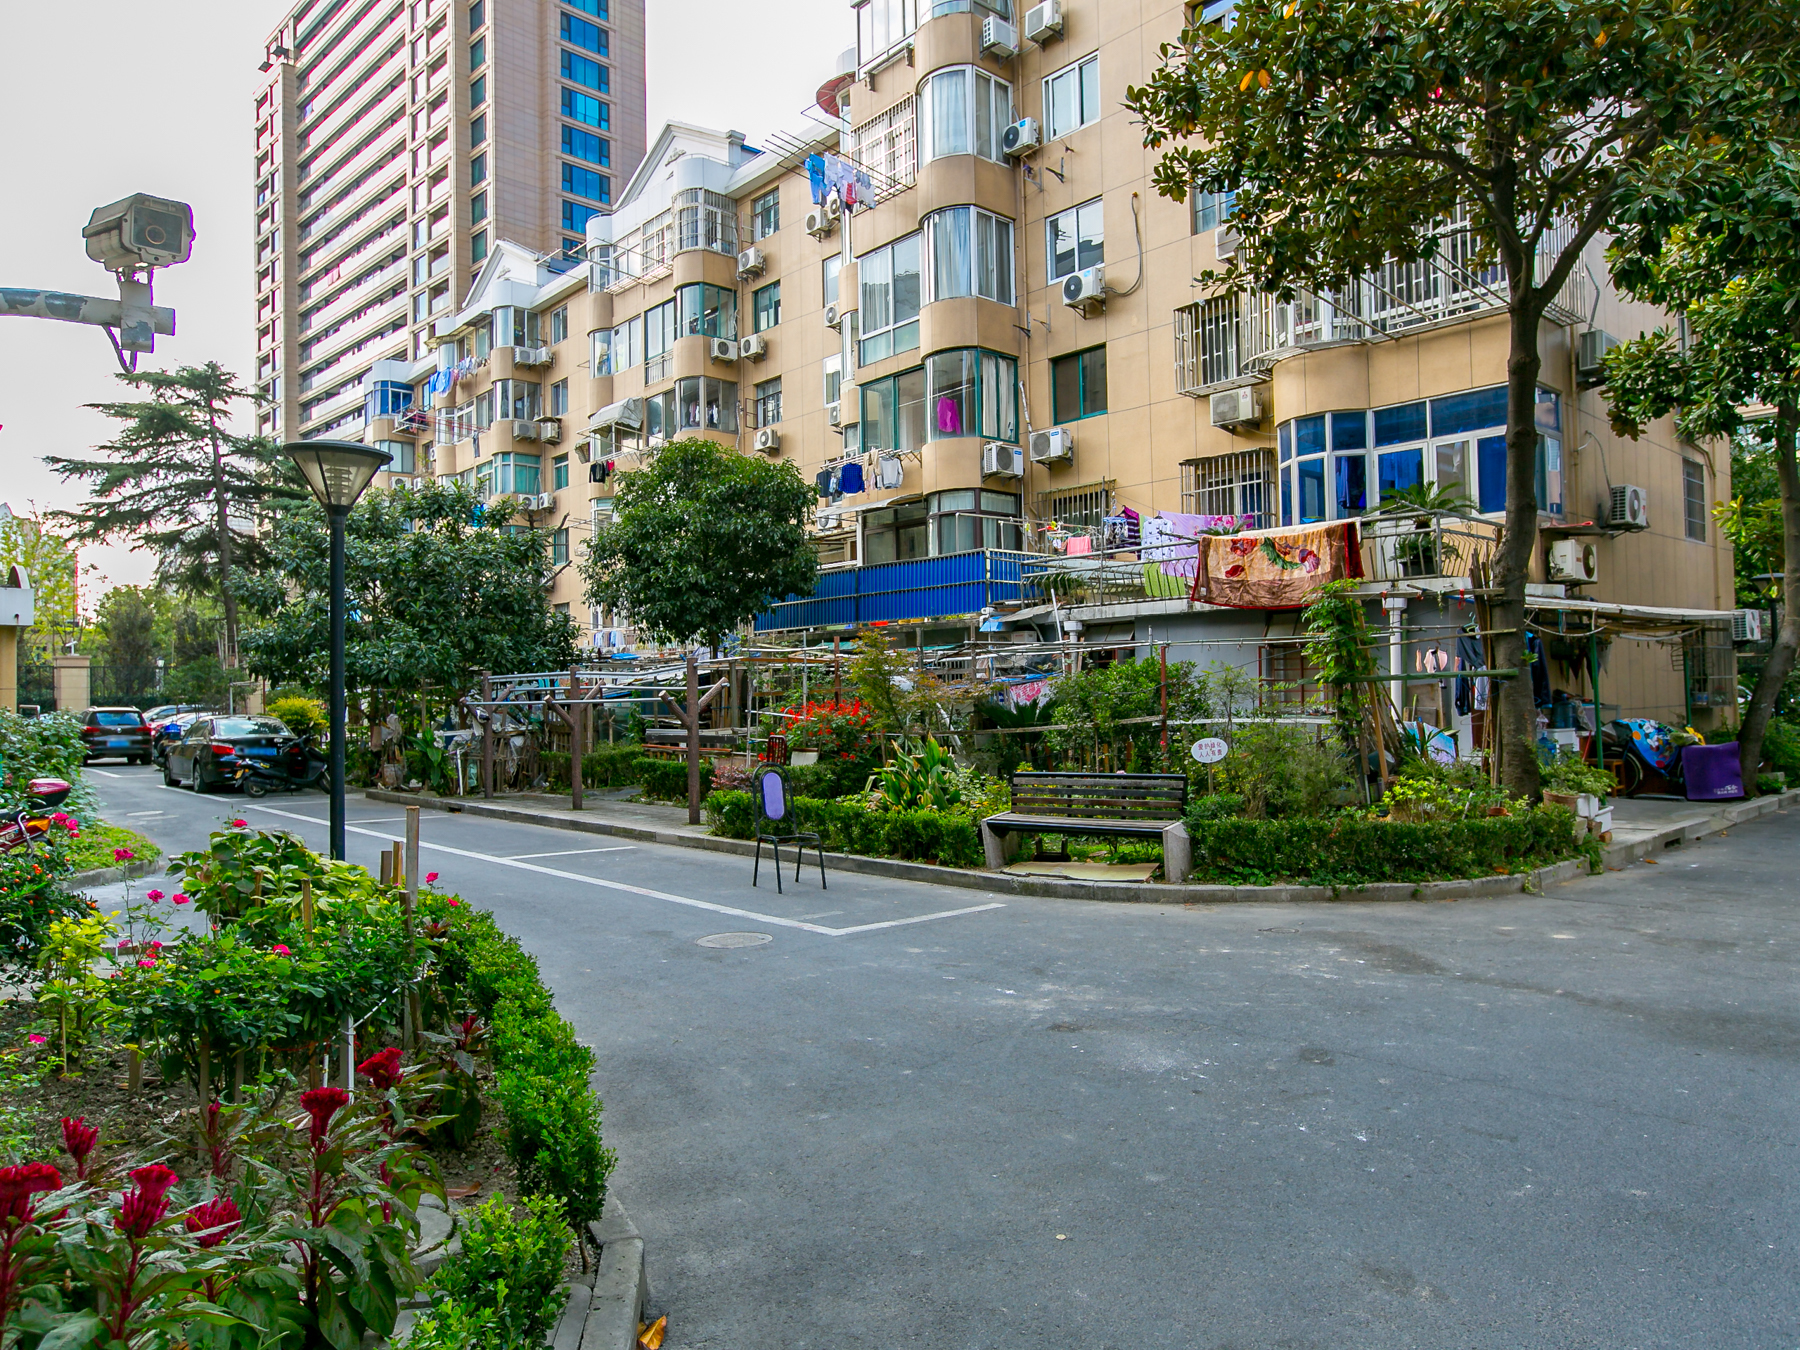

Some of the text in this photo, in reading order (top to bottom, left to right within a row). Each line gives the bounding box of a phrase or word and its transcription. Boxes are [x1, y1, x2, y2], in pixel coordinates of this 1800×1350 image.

[1198, 742, 1222, 750] 爱护绿化
[1199, 749, 1222, 758] 人人有责
